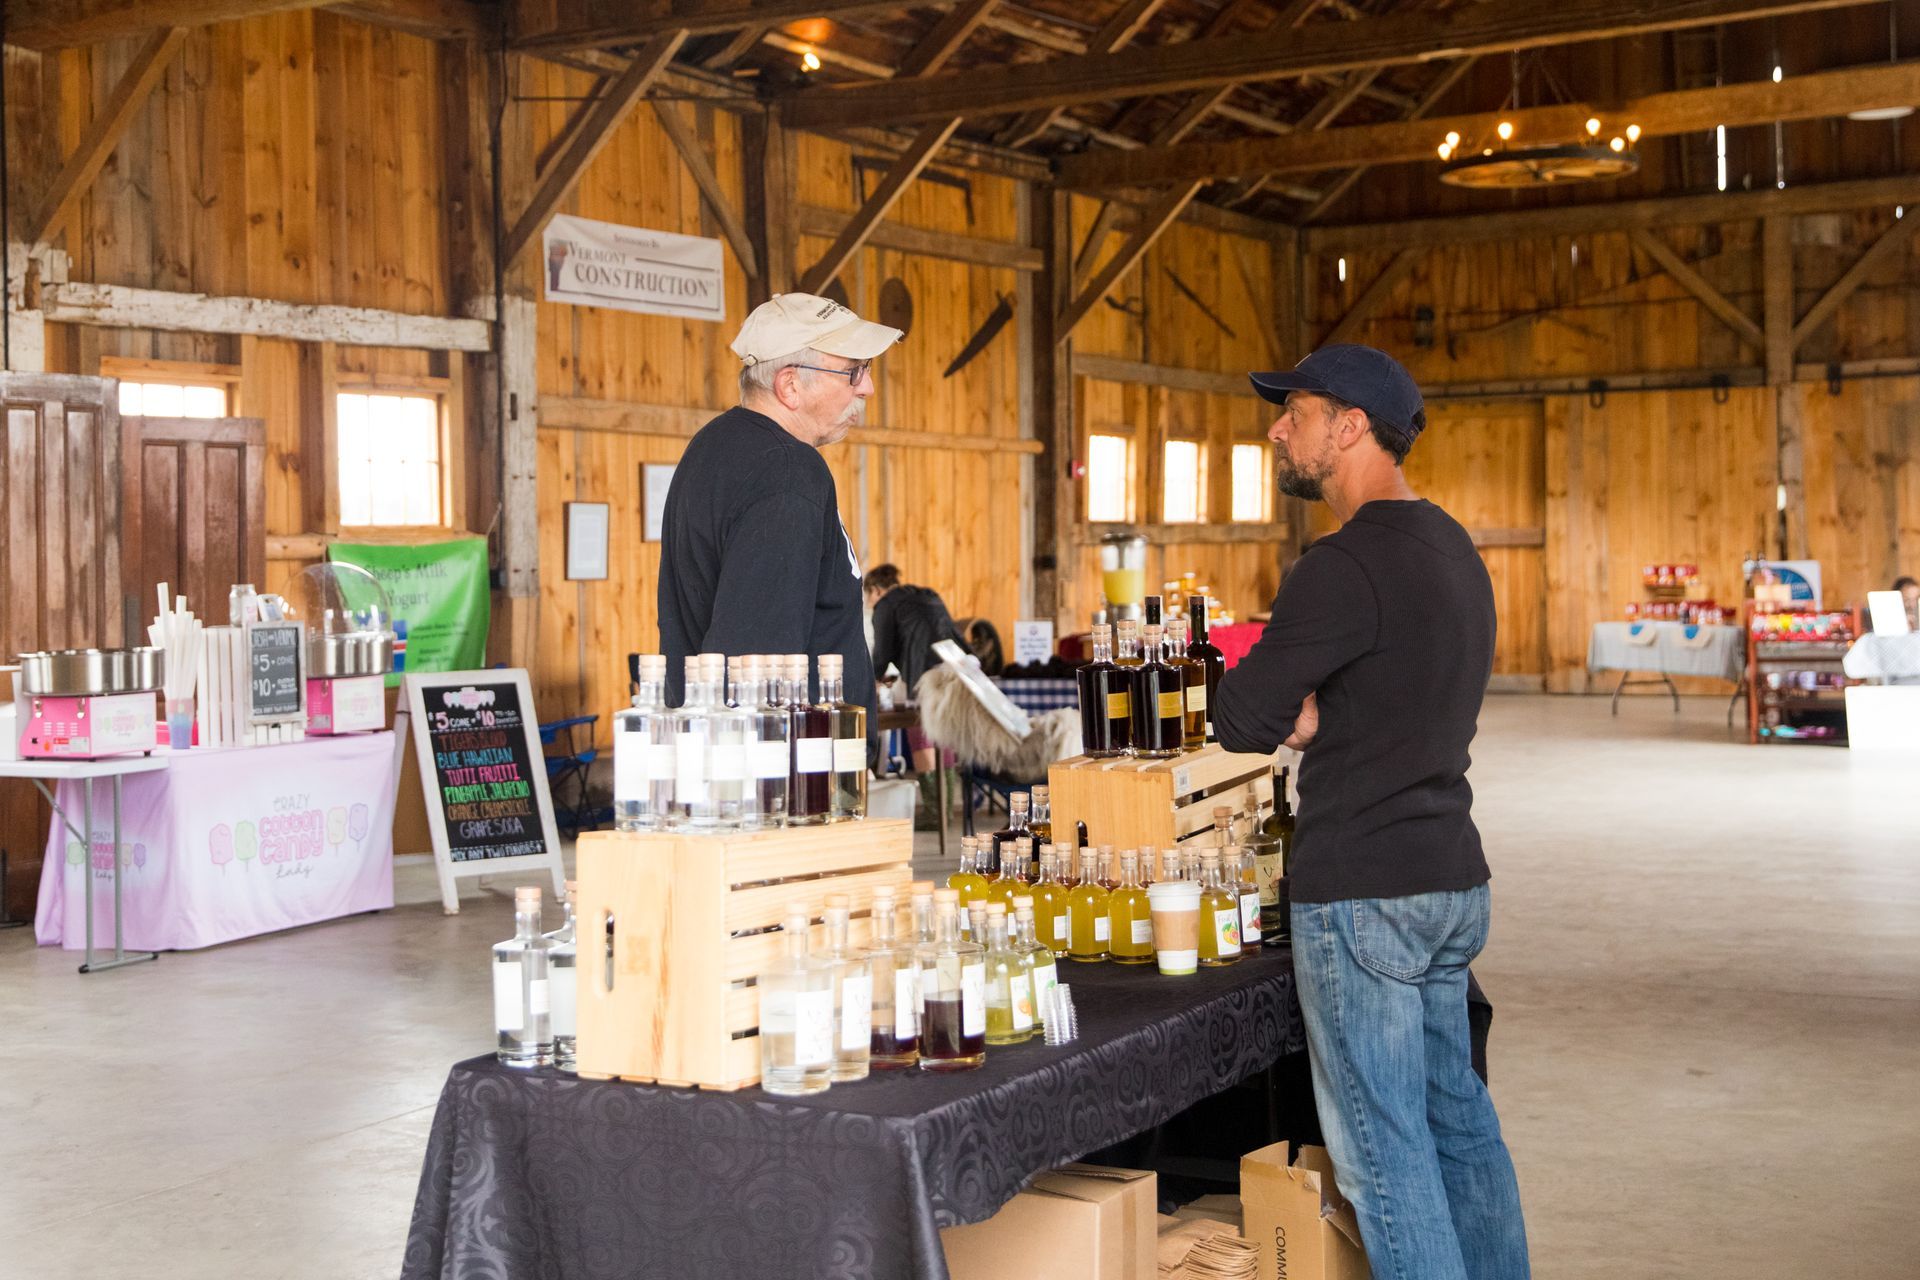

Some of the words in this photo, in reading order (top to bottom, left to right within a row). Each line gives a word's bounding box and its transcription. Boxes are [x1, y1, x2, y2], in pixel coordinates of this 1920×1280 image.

[567, 241, 627, 266] VERMONT
[574, 262, 709, 297] CONSTRUCTION
[415, 562, 448, 579] Milk
[387, 589, 429, 610] Yogurt
[436, 750, 462, 769] BLUE
[445, 767, 477, 786] TUTTI
[460, 819, 495, 840] GRAPE
[494, 817, 524, 837] SODA
